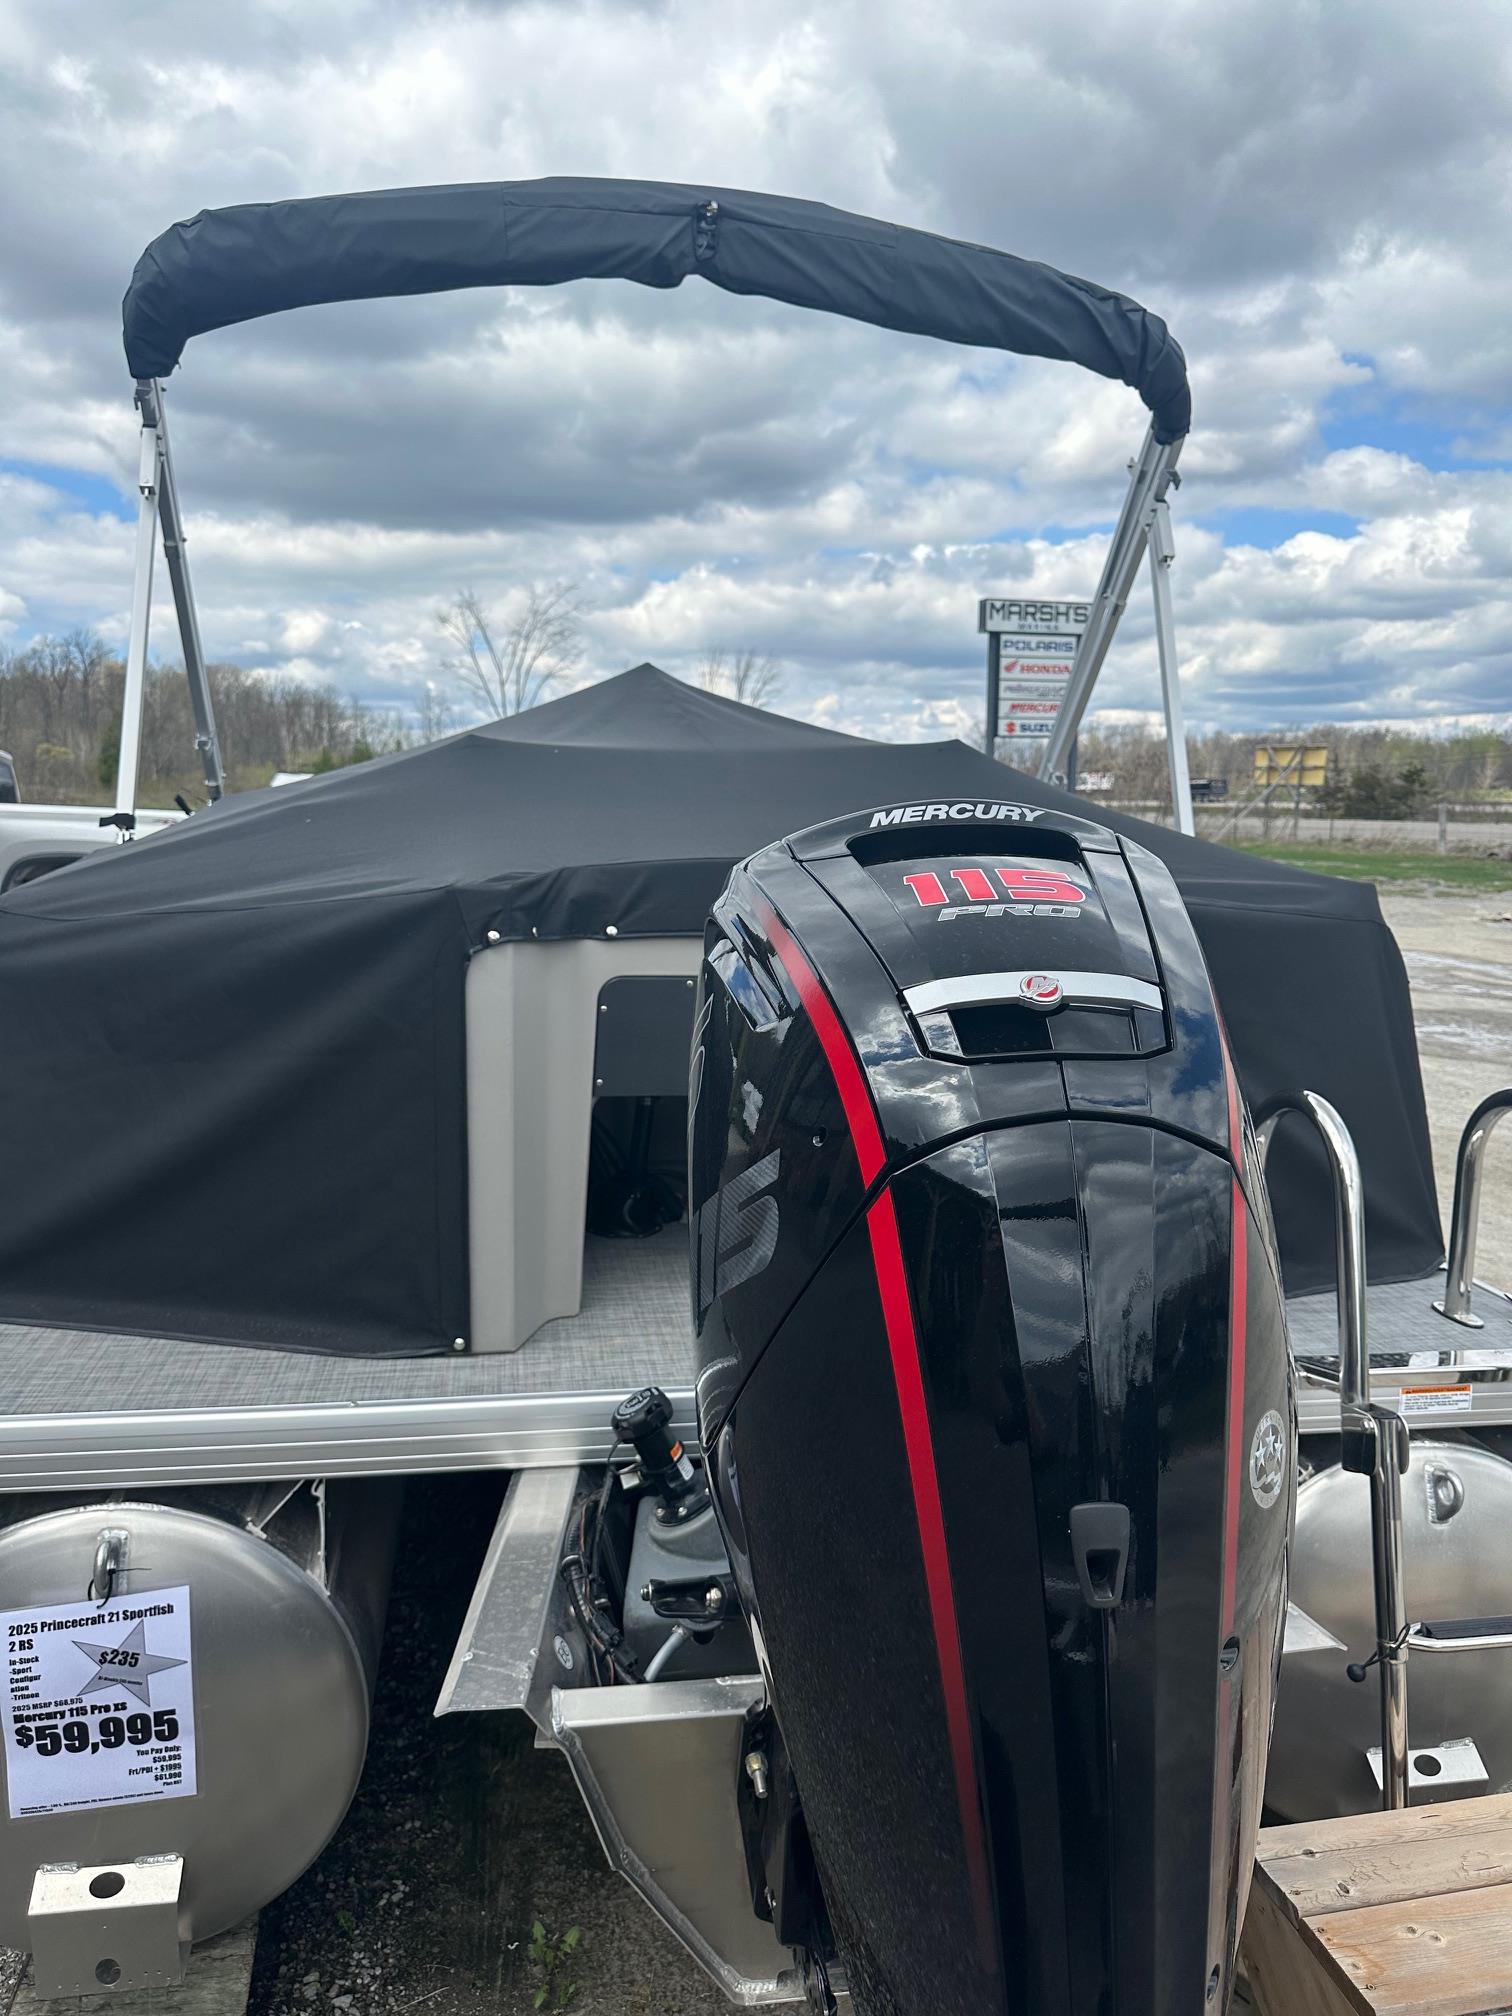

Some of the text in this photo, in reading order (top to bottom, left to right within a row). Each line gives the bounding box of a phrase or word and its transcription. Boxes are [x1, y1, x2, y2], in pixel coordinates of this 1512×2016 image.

[990, 602, 1088, 623] MARSH'S
[1003, 640, 1074, 652] POLARIS
[1019, 663, 1072, 674] HONDA
[1010, 703, 1061, 713] MERCUR
[869, 803, 1045, 828] MERCURY
[903, 868, 1086, 907] 115
[937, 903, 1081, 922] PRO
[8, 1603, 175, 1637] 2025 Princecraft 21 Sportfish
[8, 1639, 34, 1652] 2 RS
[9, 1655, 40, 1666] In-Stock
[98, 1649, 141, 1668] $235
[68, 1706, 89, 1718] 115
[14, 1708, 180, 1757] $59,995
